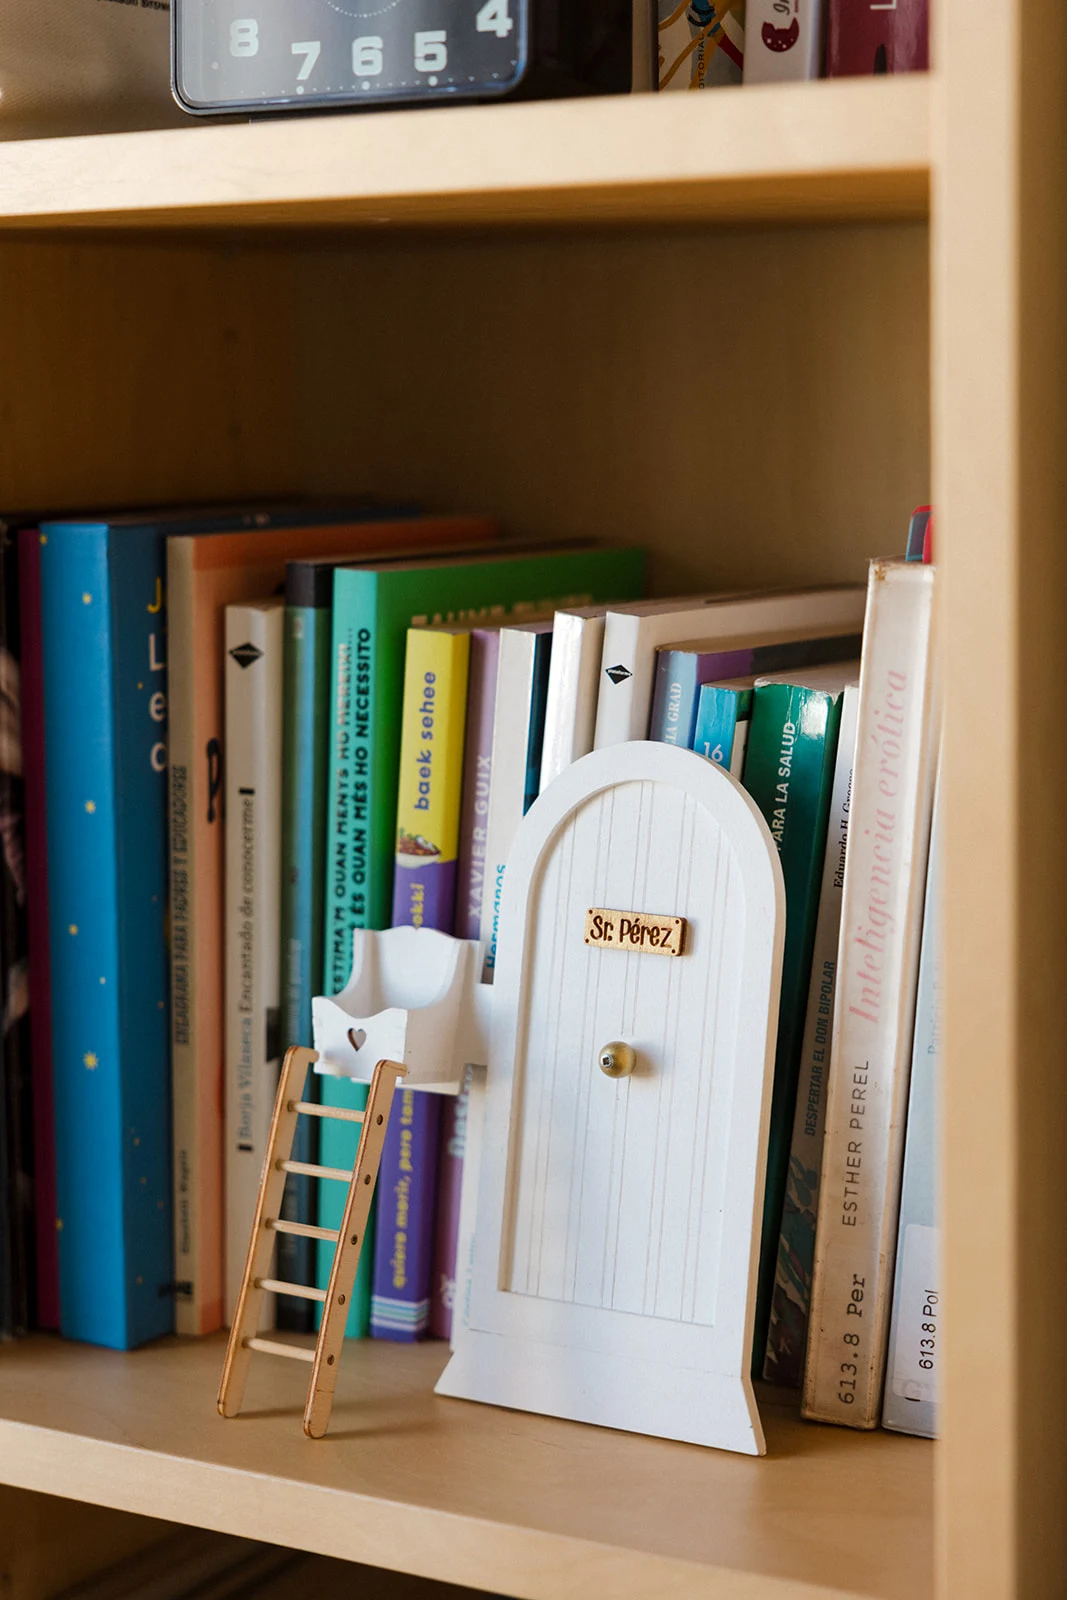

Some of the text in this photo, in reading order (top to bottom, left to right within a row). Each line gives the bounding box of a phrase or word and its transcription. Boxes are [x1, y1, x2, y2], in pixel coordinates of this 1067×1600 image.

[229, 18, 259, 58] 8
[476, 0, 513, 38] 4
[291, 41, 321, 81] 7
[351, 36, 384, 77] 6
[413, 30, 447, 72] 5
[355, 628, 372, 738] NECESSITO
[354, 746, 368, 776] HO
[413, 671, 436, 811] baek sehee
[703, 741, 724, 762] 16
[350, 780, 368, 822] MÉS
[771, 722, 796, 850] ARA LA SALUD
[352, 828, 367, 886] QUAN
[468, 755, 492, 917] XAVIER GUIX
[848, 669, 907, 1024] Inteligencia erótica
[335, 843, 349, 899] QUAN
[590, 915, 673, 948] Sr. Pérez
[804, 960, 836, 1137] DESPERTAR EL DON BIPOLAR
[841, 1060, 870, 1228] ESTHER PEREL
[837, 1272, 866, 1406] 613.8 Per
[918, 1289, 939, 1370] 613.8 Pol
